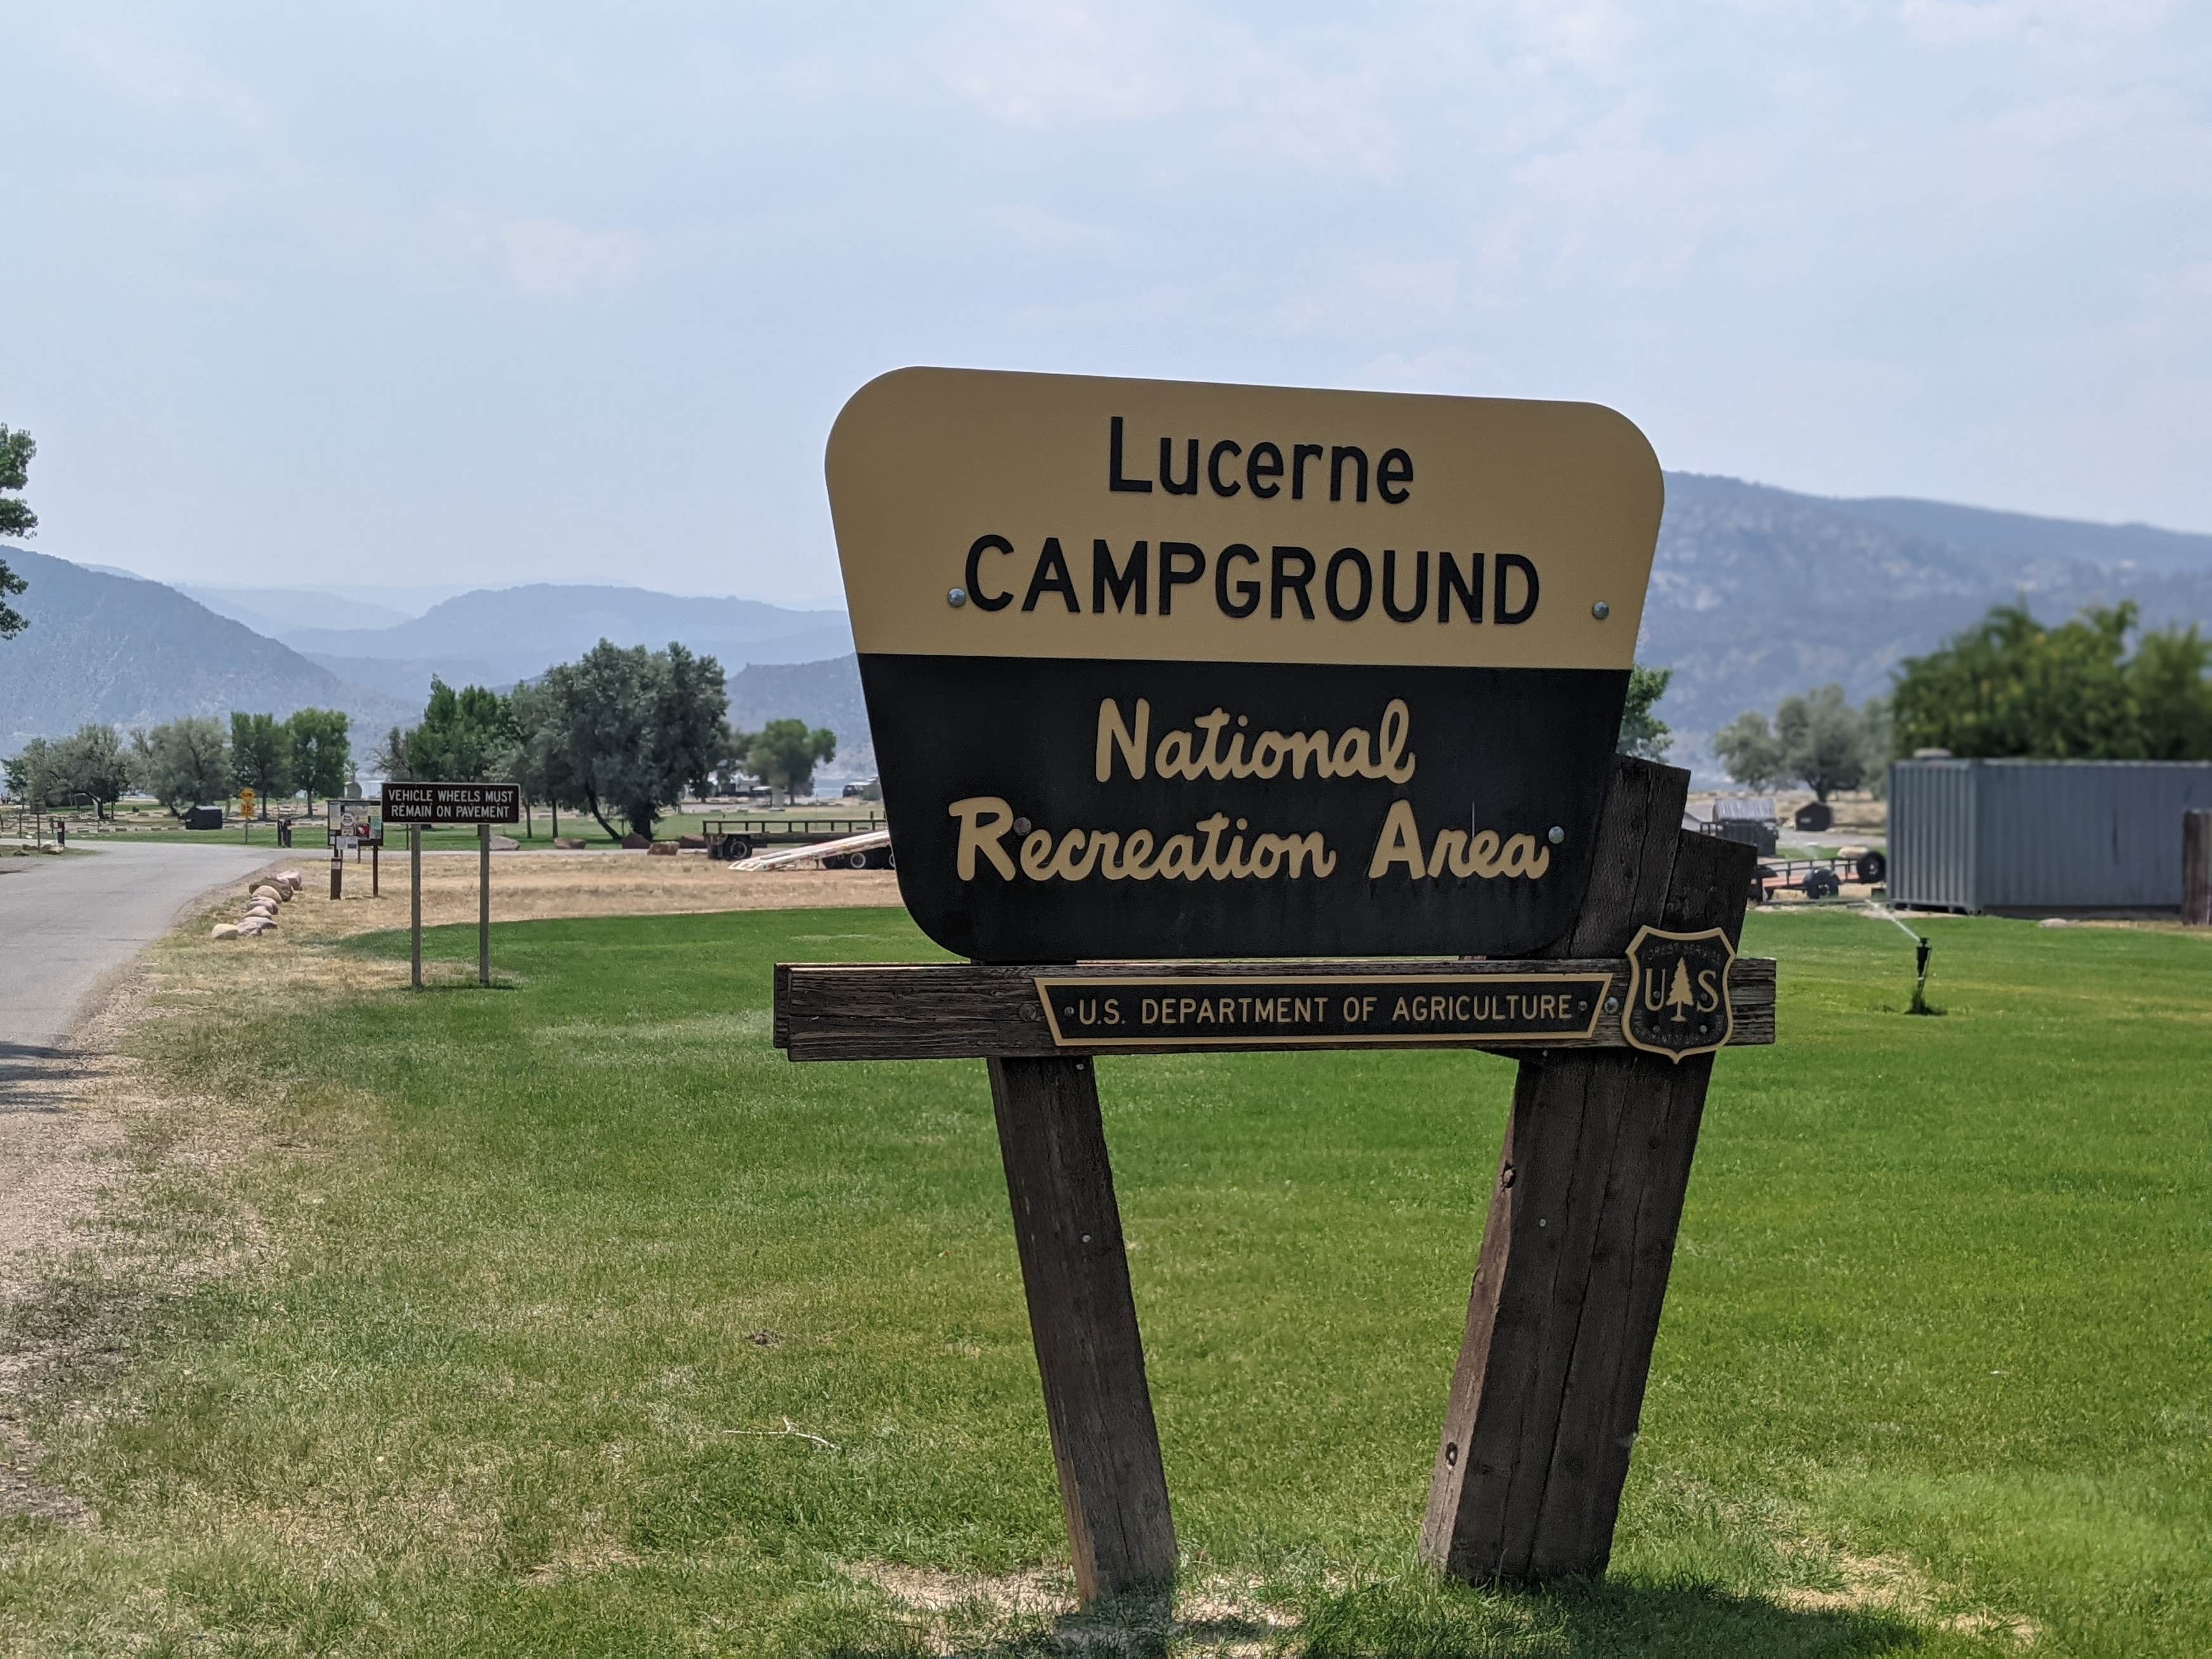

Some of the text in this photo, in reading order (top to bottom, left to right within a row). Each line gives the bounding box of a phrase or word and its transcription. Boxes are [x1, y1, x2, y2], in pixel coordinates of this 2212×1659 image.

[1109, 415, 1415, 507] Lucerne
[966, 533, 1540, 627] CAMPGROUND
[1095, 698, 1416, 784] National
[388, 789, 514, 803] VEHICLE WHEELS MUST
[391, 805, 432, 817] REMAIN
[436, 805, 452, 817] ON
[455, 805, 510, 818] PAVEMENT
[948, 796, 1550, 882] Recreation Area
[1079, 994, 1573, 1025] U.S. DEPARTMENT OF AGRICULTURE
